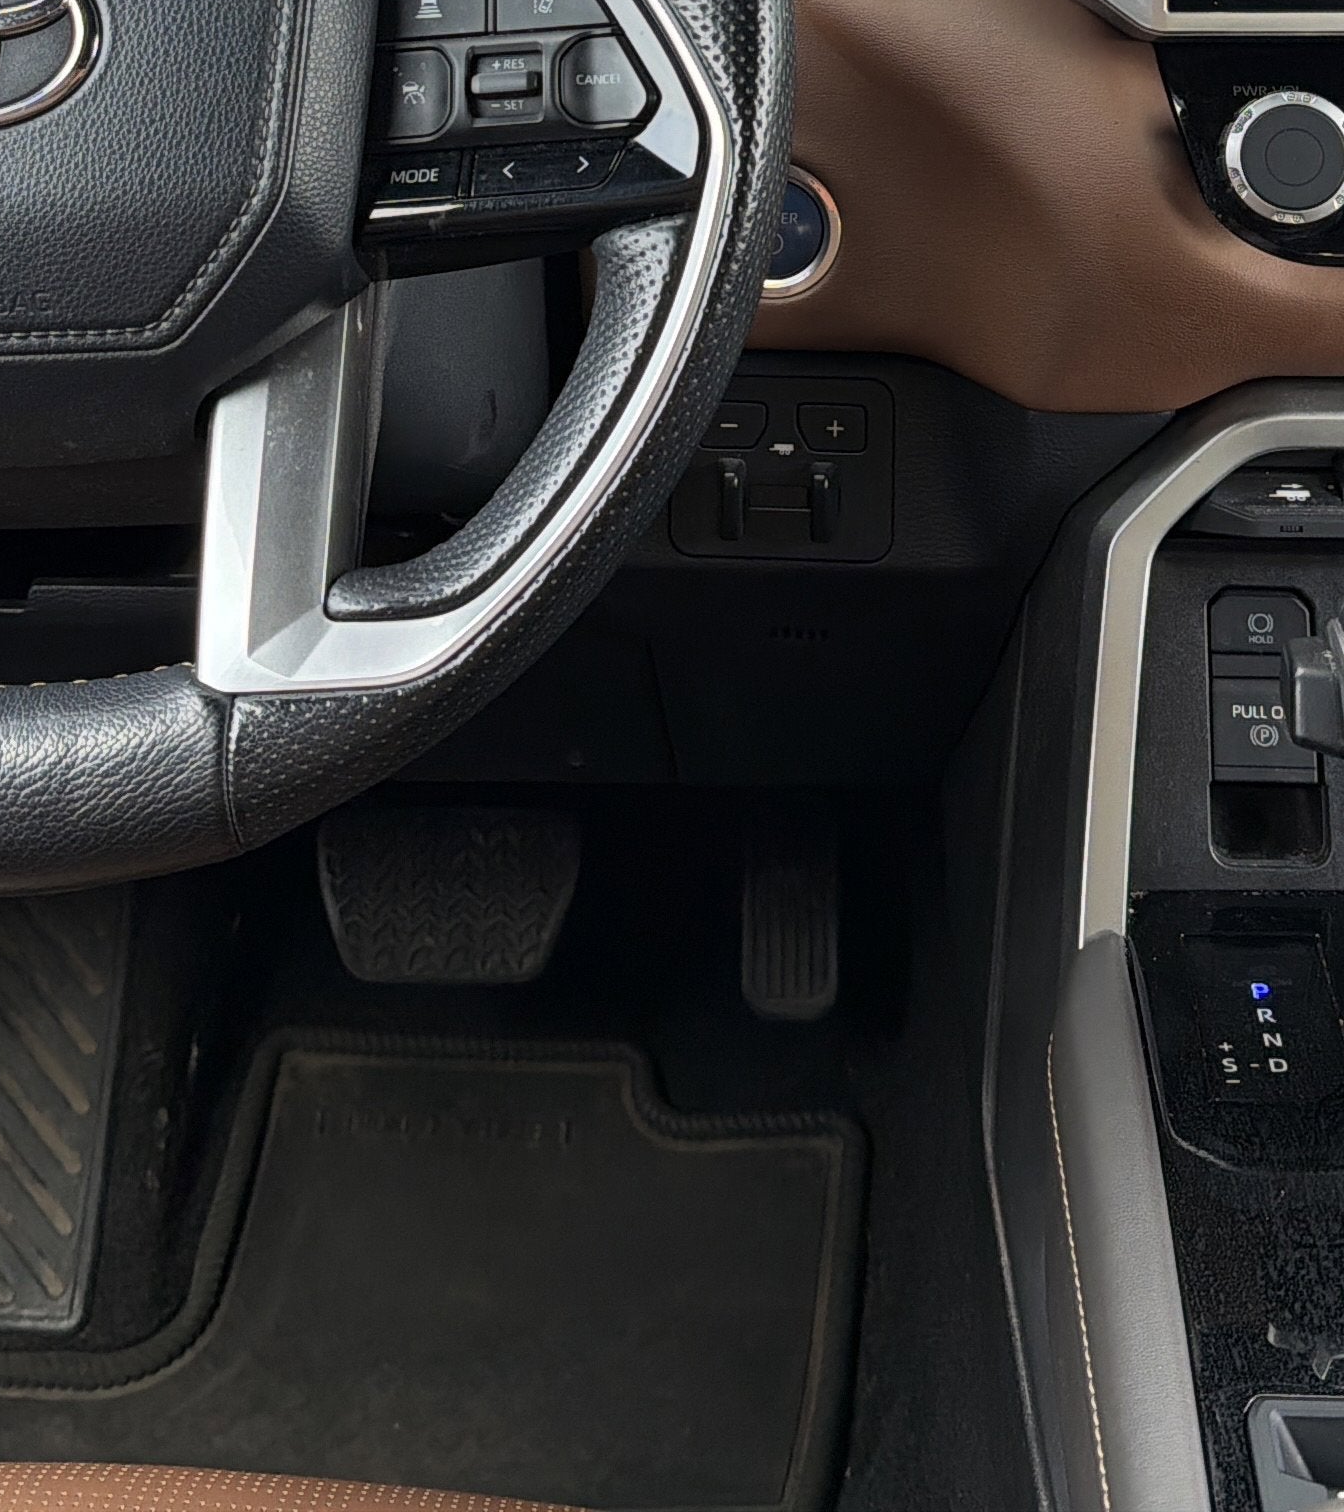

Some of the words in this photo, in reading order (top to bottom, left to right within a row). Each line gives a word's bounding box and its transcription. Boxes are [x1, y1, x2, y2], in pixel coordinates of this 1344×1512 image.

[389, 167, 440, 184] MODE
[1248, 635, 1274, 645] HOLD
[1232, 704, 1267, 720] PULL
[1271, 705, 1286, 720] O
[1250, 982, 1270, 999] P
[1256, 1008, 1277, 1024] R
[1262, 1032, 1283, 1048] N
[1221, 1057, 1238, 1073] S
[1269, 1058, 1288, 1073] D
